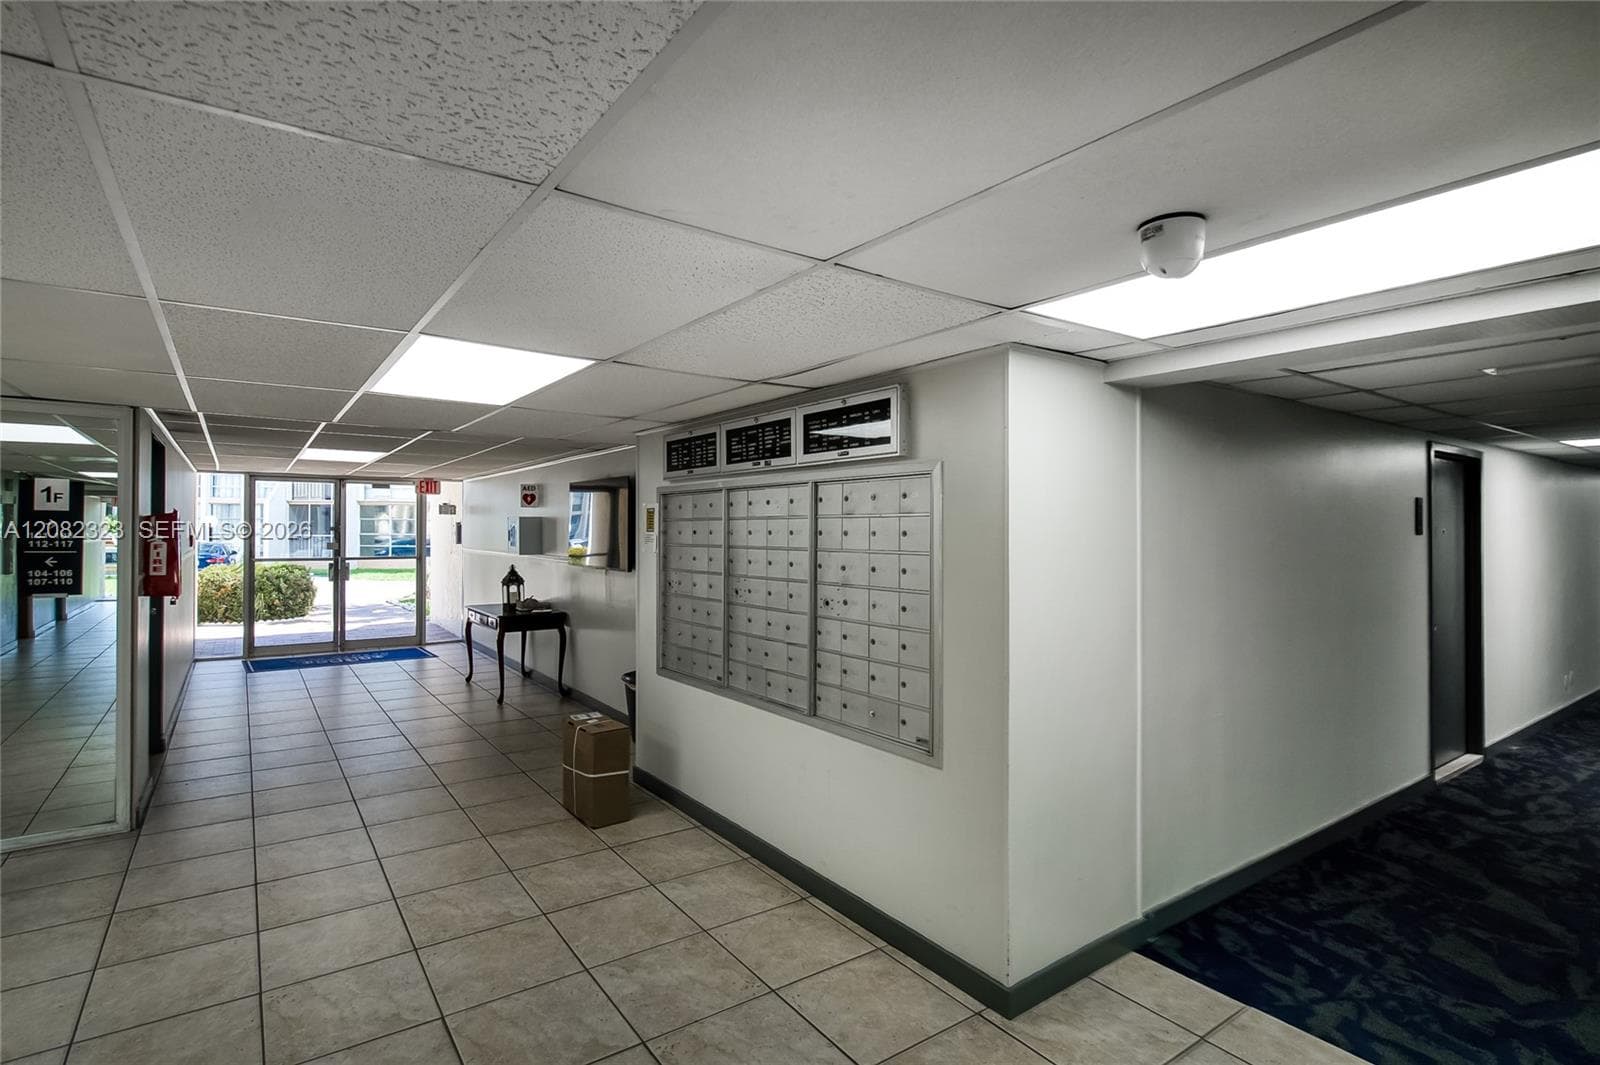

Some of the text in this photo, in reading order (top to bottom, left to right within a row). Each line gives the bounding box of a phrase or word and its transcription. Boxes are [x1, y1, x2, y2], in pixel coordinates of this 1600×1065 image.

[419, 481, 438, 494] EXIT
[40, 486, 64, 503] 1F
[28, 540, 74, 548] 112-117
[152, 543, 163, 573] FIRE
[27, 569, 73, 577] 104-106
[27, 578, 74, 586] 107-110
